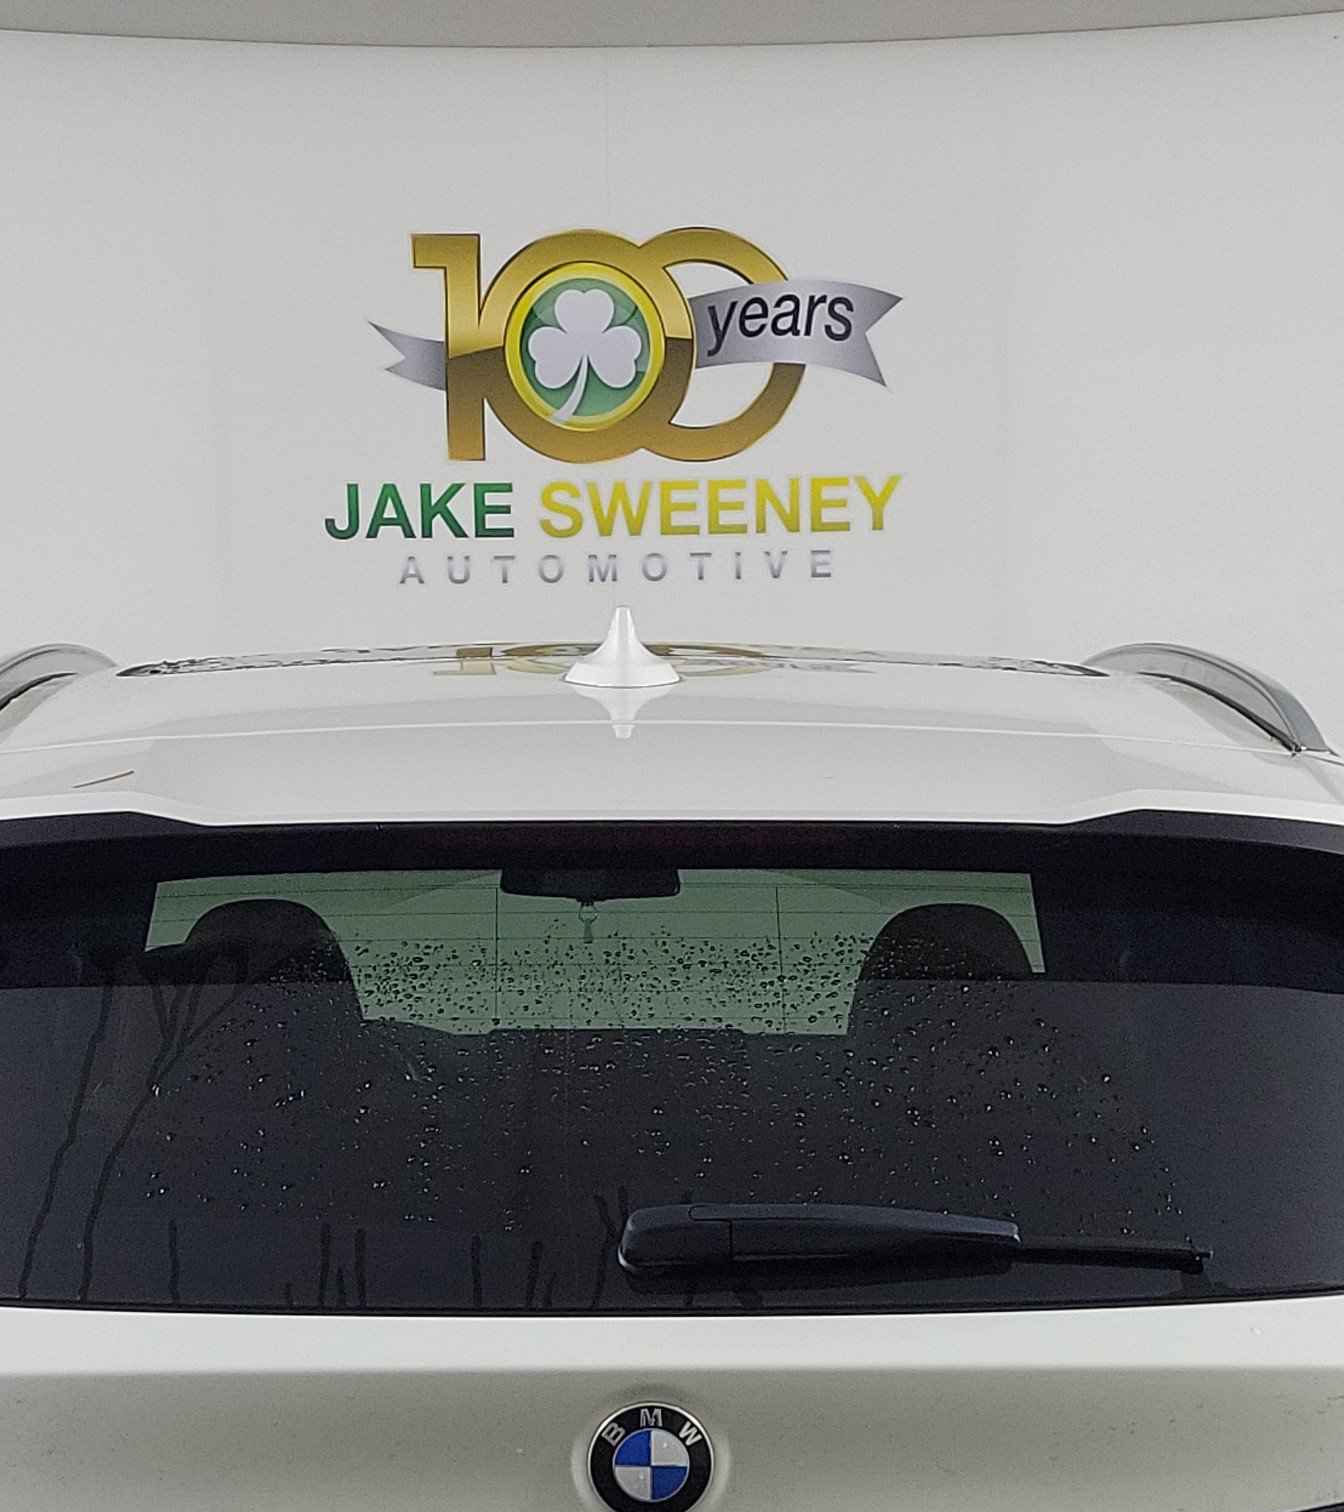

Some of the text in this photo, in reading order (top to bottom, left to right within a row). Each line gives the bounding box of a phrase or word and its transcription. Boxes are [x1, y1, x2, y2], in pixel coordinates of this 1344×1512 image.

[706, 293, 854, 356] years
[324, 475, 901, 540] JAKE SWEENEY
[399, 549, 833, 585] AUTOMOTIVE
[601, 1407, 702, 1446] BMW
